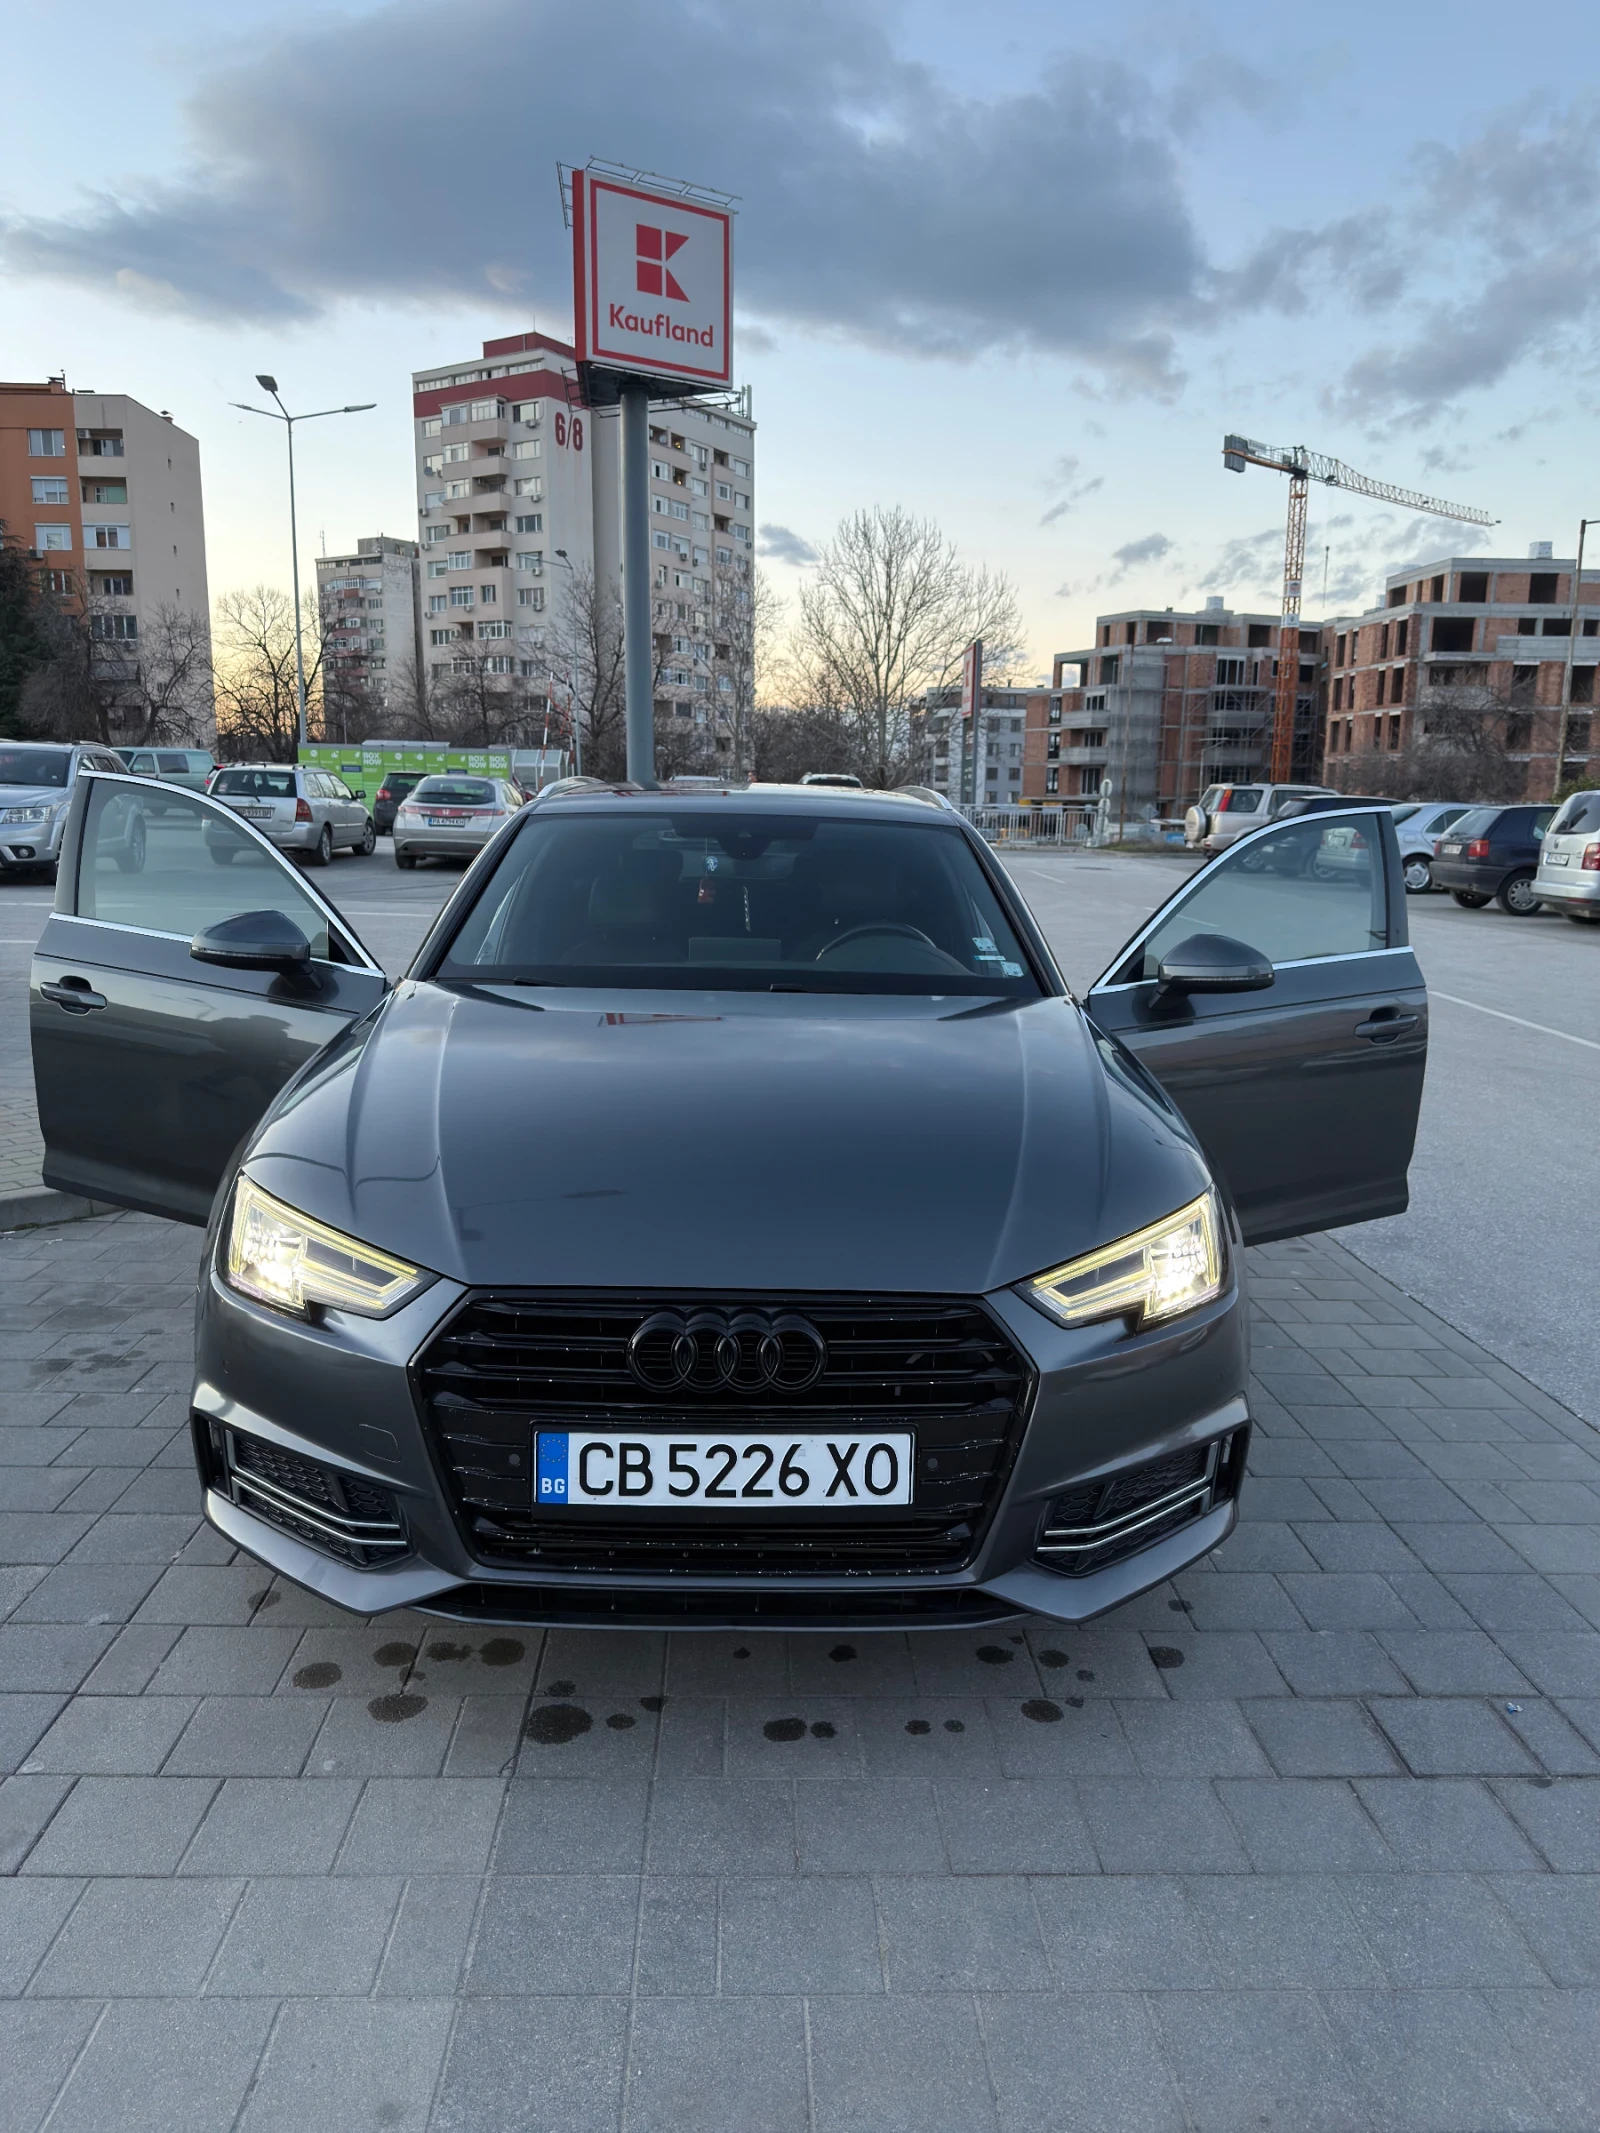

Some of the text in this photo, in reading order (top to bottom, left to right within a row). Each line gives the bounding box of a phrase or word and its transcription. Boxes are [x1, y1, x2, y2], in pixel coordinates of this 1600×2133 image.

[609, 303, 714, 348] Kaufland
[555, 412, 583, 451] 6/8
[541, 1477, 565, 1494] BG
[579, 1442, 653, 1496] CB
[669, 1444, 810, 1497] 5226
